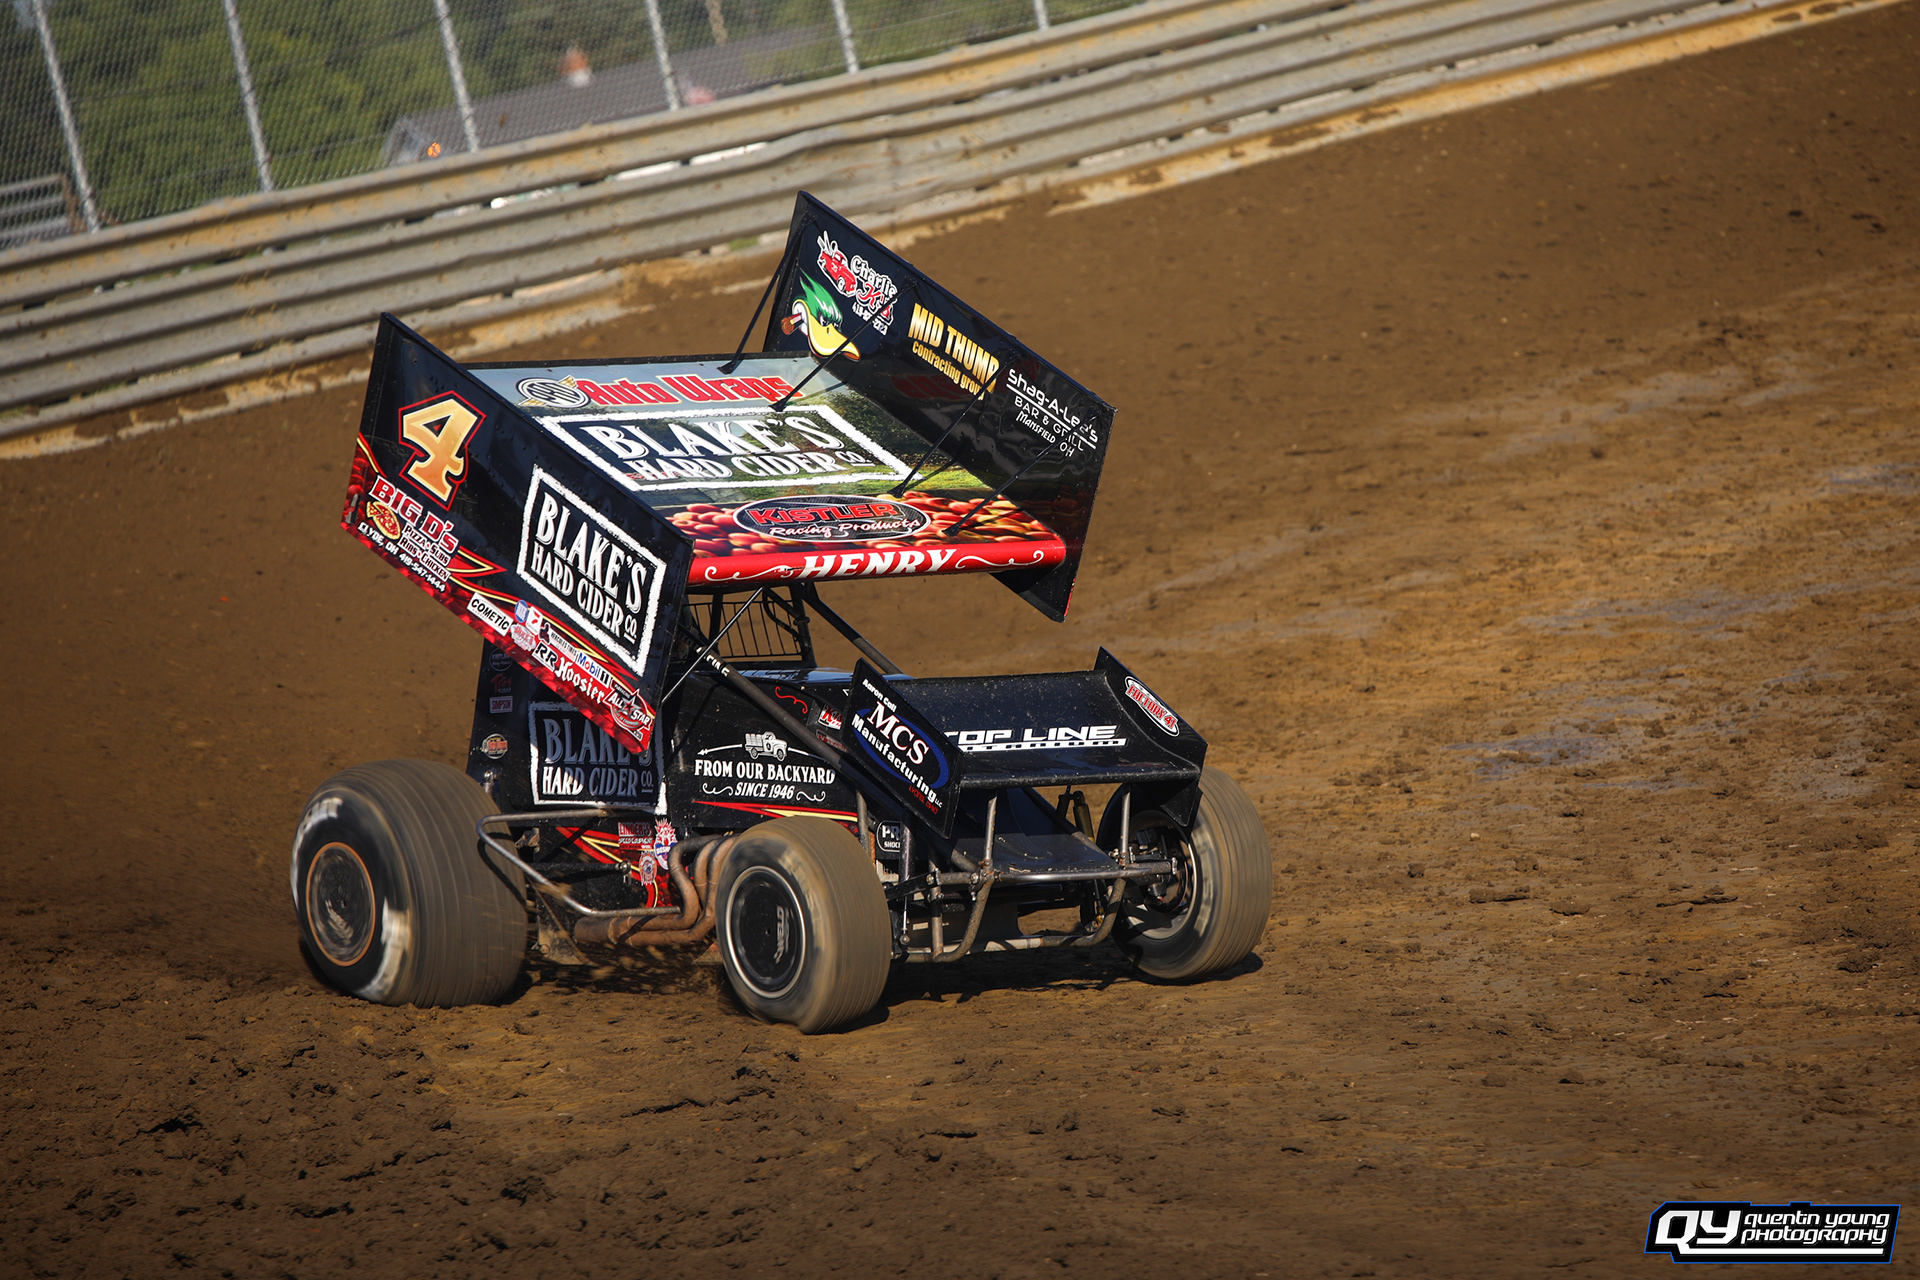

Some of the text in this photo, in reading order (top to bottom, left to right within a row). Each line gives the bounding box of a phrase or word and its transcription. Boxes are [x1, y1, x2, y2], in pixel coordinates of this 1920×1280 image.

[852, 256, 897, 298] Charlie
[908, 302, 945, 347] MID
[912, 340, 961, 384] contracting
[577, 377, 682, 406] Auto
[656, 374, 806, 403] Wraps
[1014, 396, 1039, 419] BAR
[1042, 415, 1049, 425] &
[402, 397, 478, 502] 4
[580, 416, 845, 459] BLAKE'S
[1060, 442, 1075, 457] OH
[624, 458, 733, 481] HARD
[731, 452, 848, 477] CIDER
[369, 475, 424, 527] BIG
[747, 503, 902, 525] KISTLER
[402, 522, 428, 549] PIZZA
[770, 519, 921, 538] Racing Products
[385, 541, 400, 555] OH
[397, 535, 418, 557] RIBS
[535, 492, 648, 614] BLAKE'S
[796, 549, 958, 578] HENRY
[531, 540, 574, 596] HARD
[576, 578, 624, 638] CIDER
[554, 656, 606, 704] Hoosier
[577, 652, 601, 678] Mobil
[600, 670, 609, 685] 1
[862, 679, 884, 700] Aaron
[608, 692, 623, 708] ALL
[630, 709, 651, 725] STAR
[1164, 715, 1176, 729] 41
[867, 700, 930, 765] MCS
[1022, 725, 1117, 741] LINE
[694, 759, 836, 784] FROM OUR BACKYARD
[851, 714, 938, 803] Manufacturing
[542, 766, 585, 795] HARD
[588, 767, 639, 797] CIDER
[734, 781, 795, 799] SINCE 1946
